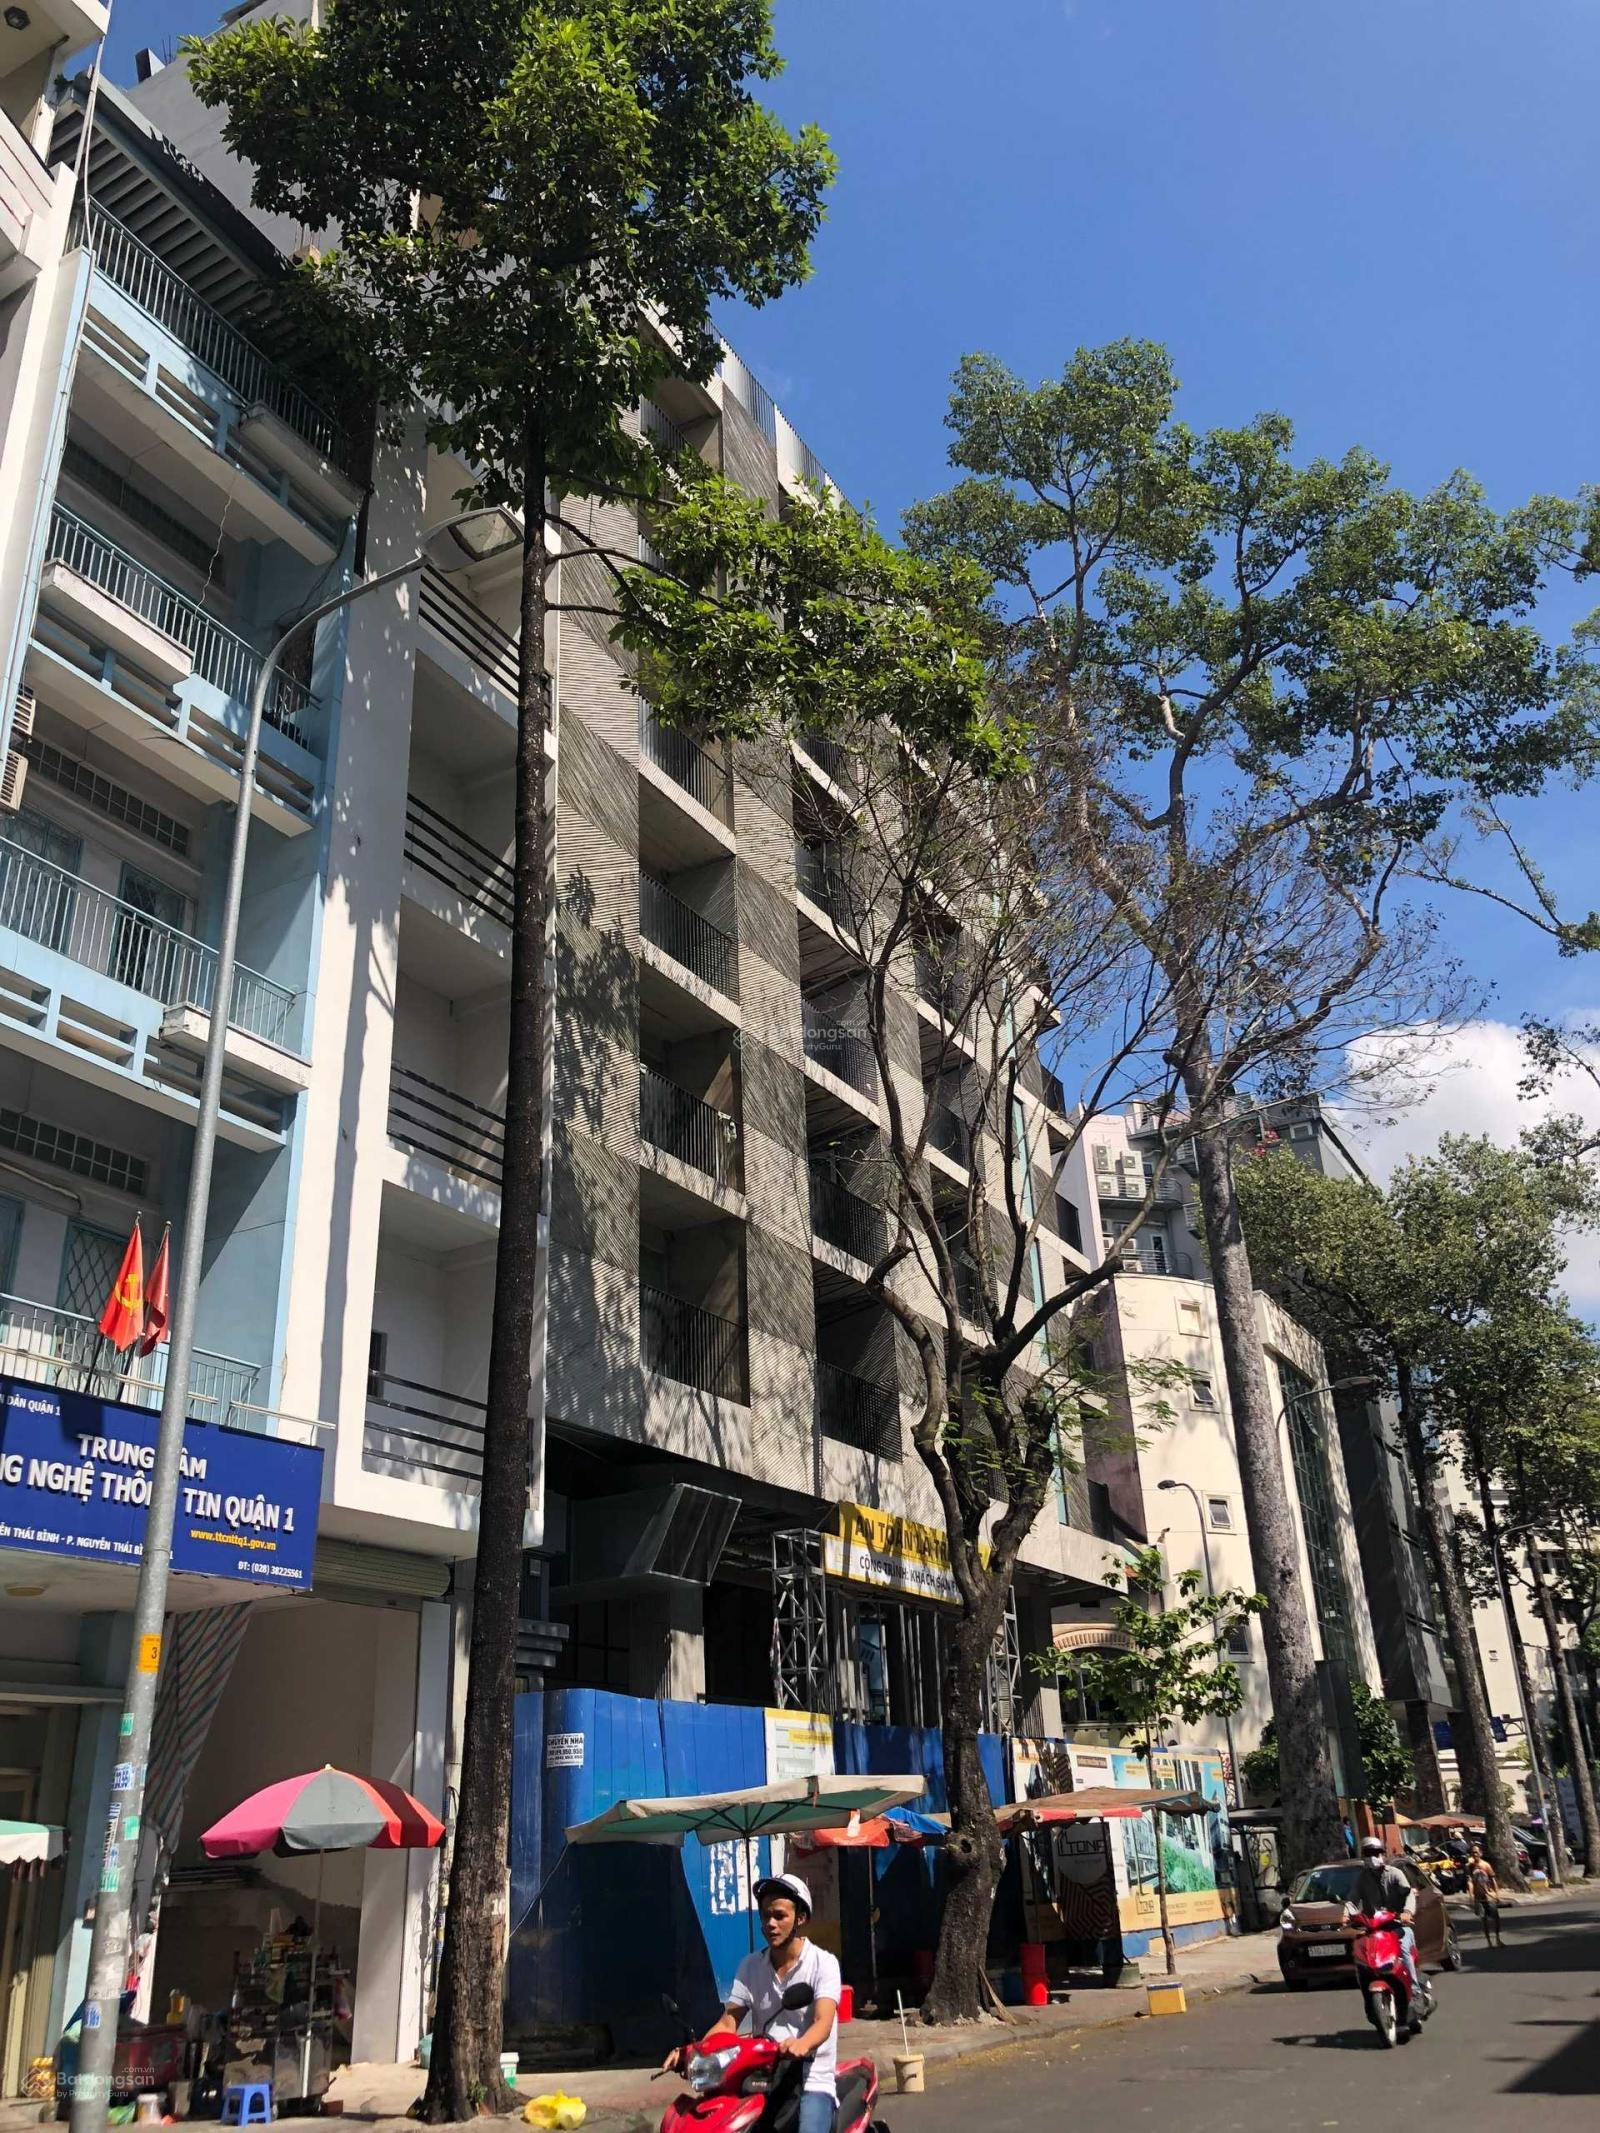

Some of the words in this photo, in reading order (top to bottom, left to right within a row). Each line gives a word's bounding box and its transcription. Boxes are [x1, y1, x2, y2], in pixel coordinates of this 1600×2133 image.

[28, 1400, 54, 1416] QUẬN
[54, 1405, 61, 1417] 1
[78, 1433, 156, 1470] TRUNG
[179, 1447, 208, 1480] ÂM
[27, 1459, 95, 1503] NGHỆ
[101, 1469, 153, 1507] THÔ
[183, 1487, 221, 1518] TIN
[224, 1494, 280, 1531] QUẬN
[283, 1507, 294, 1531] 1
[13, 1527, 35, 1540] THÁI
[36, 1528, 60, 1544] BÌNH
[66, 1535, 75, 1546] P.
[76, 1537, 111, 1551] NGUYỄN
[113, 1541, 133, 1554] THÁI
[190, 1529, 277, 1551] www.ttcnttq1.gov.vn
[855, 1513, 875, 1542] AN
[238, 1560, 250, 1571] ĐT:
[251, 1563, 270, 1576] (028)
[859, 1553, 882, 1575] CÔNG
[883, 1559, 910, 1581] TRÌNH:
[910, 1566, 935, 1588] KHÁCH
